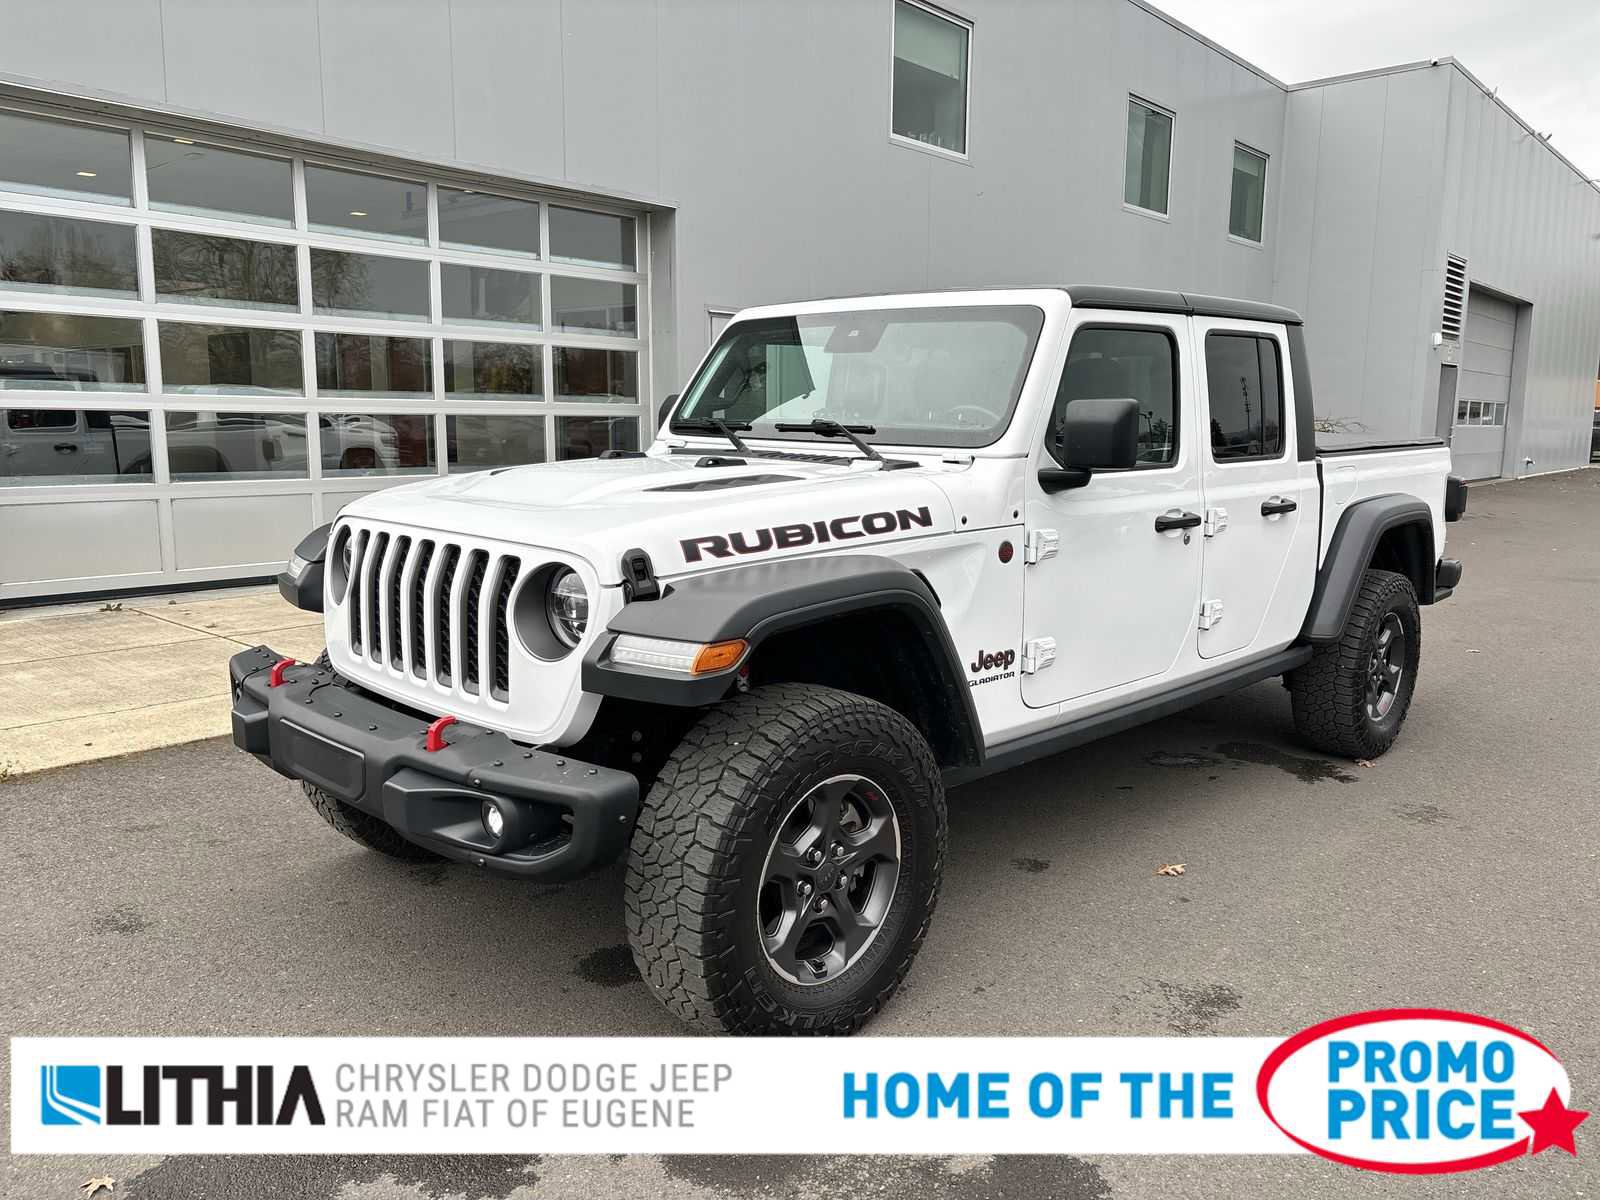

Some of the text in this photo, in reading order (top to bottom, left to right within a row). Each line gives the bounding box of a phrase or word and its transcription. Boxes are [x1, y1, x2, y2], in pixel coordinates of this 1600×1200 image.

[680, 506, 933, 563] RUBICON
[971, 649, 1015, 672] Jeep
[968, 671, 1015, 687] GLADIATOR
